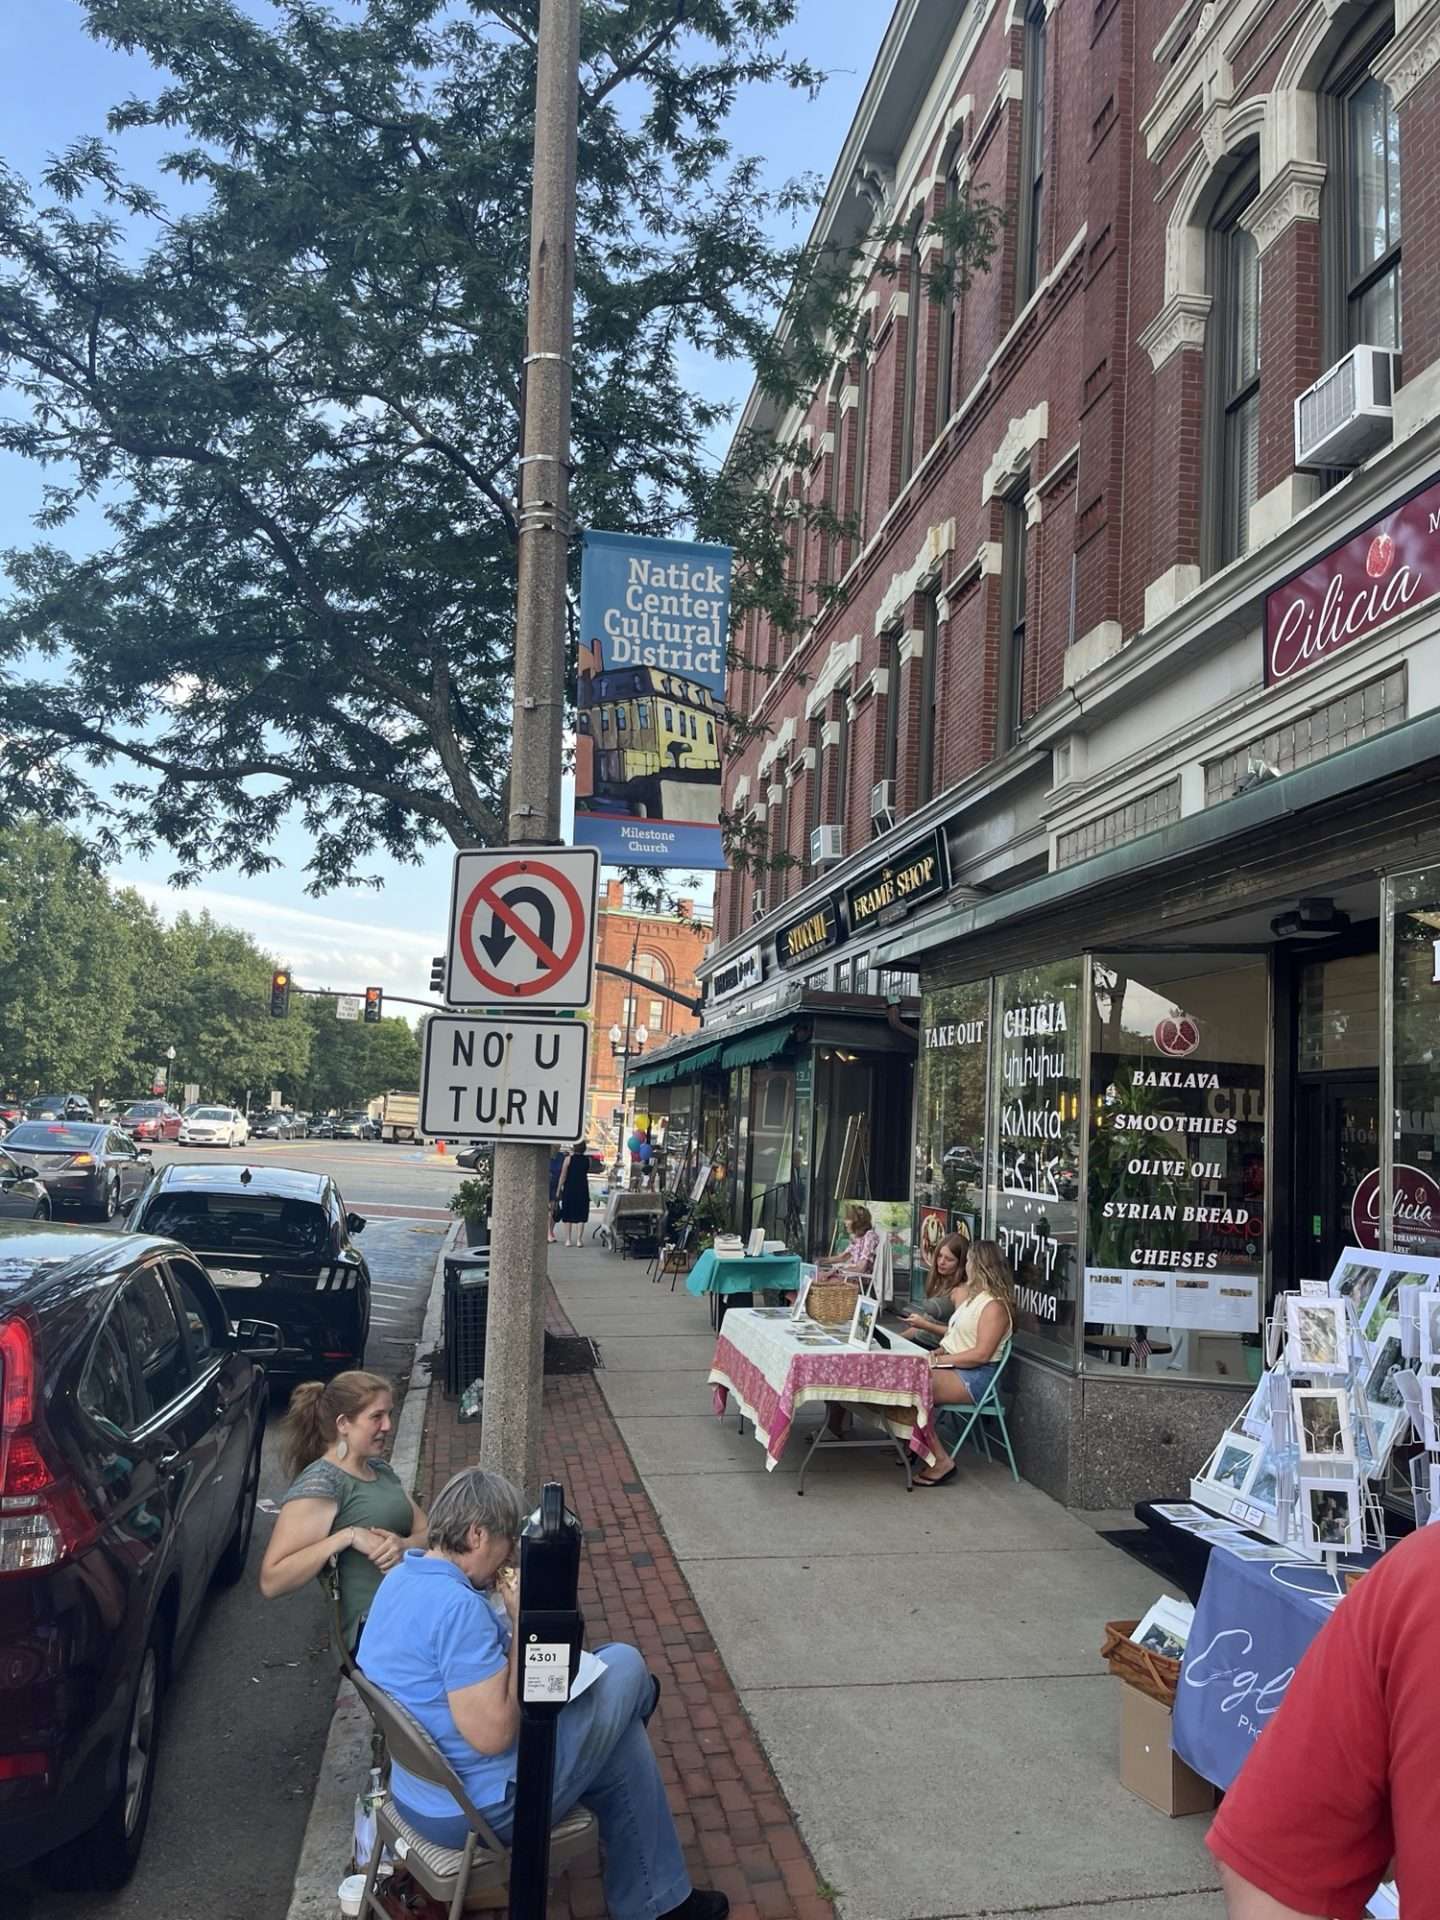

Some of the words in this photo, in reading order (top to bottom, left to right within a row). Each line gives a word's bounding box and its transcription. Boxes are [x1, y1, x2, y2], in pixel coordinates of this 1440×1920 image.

[628, 558, 725, 594] Natick
[626, 585, 724, 620] Center
[604, 608, 721, 647] Cultural
[1272, 566, 1422, 677] Cilicia
[610, 635, 721, 673] District
[621, 827, 676, 841] Milestone
[628, 841, 669, 853] Church
[853, 882, 895, 921] FRAME
[896, 856, 934, 896] SHOP
[925, 1026, 954, 1049] TAKE
[957, 1021, 984, 1045] OUT
[1003, 1001, 1067, 1039] CILICIA
[452, 1030, 505, 1068] NO
[535, 1033, 560, 1070] U
[1132, 1070, 1220, 1089] BAKLAVA
[449, 1086, 559, 1126] TURN
[1113, 1114, 1238, 1135] SMOOTHIES
[1128, 1159, 1185, 1177] OLIVE
[1190, 1162, 1222, 1179] OIL
[1102, 1202, 1177, 1221] SYRIAN
[1182, 1206, 1249, 1225] BREAD
[1367, 1186, 1433, 1228] Clicia
[1130, 1249, 1218, 1269] CHEESES
[529, 1653, 557, 1662] 4301
